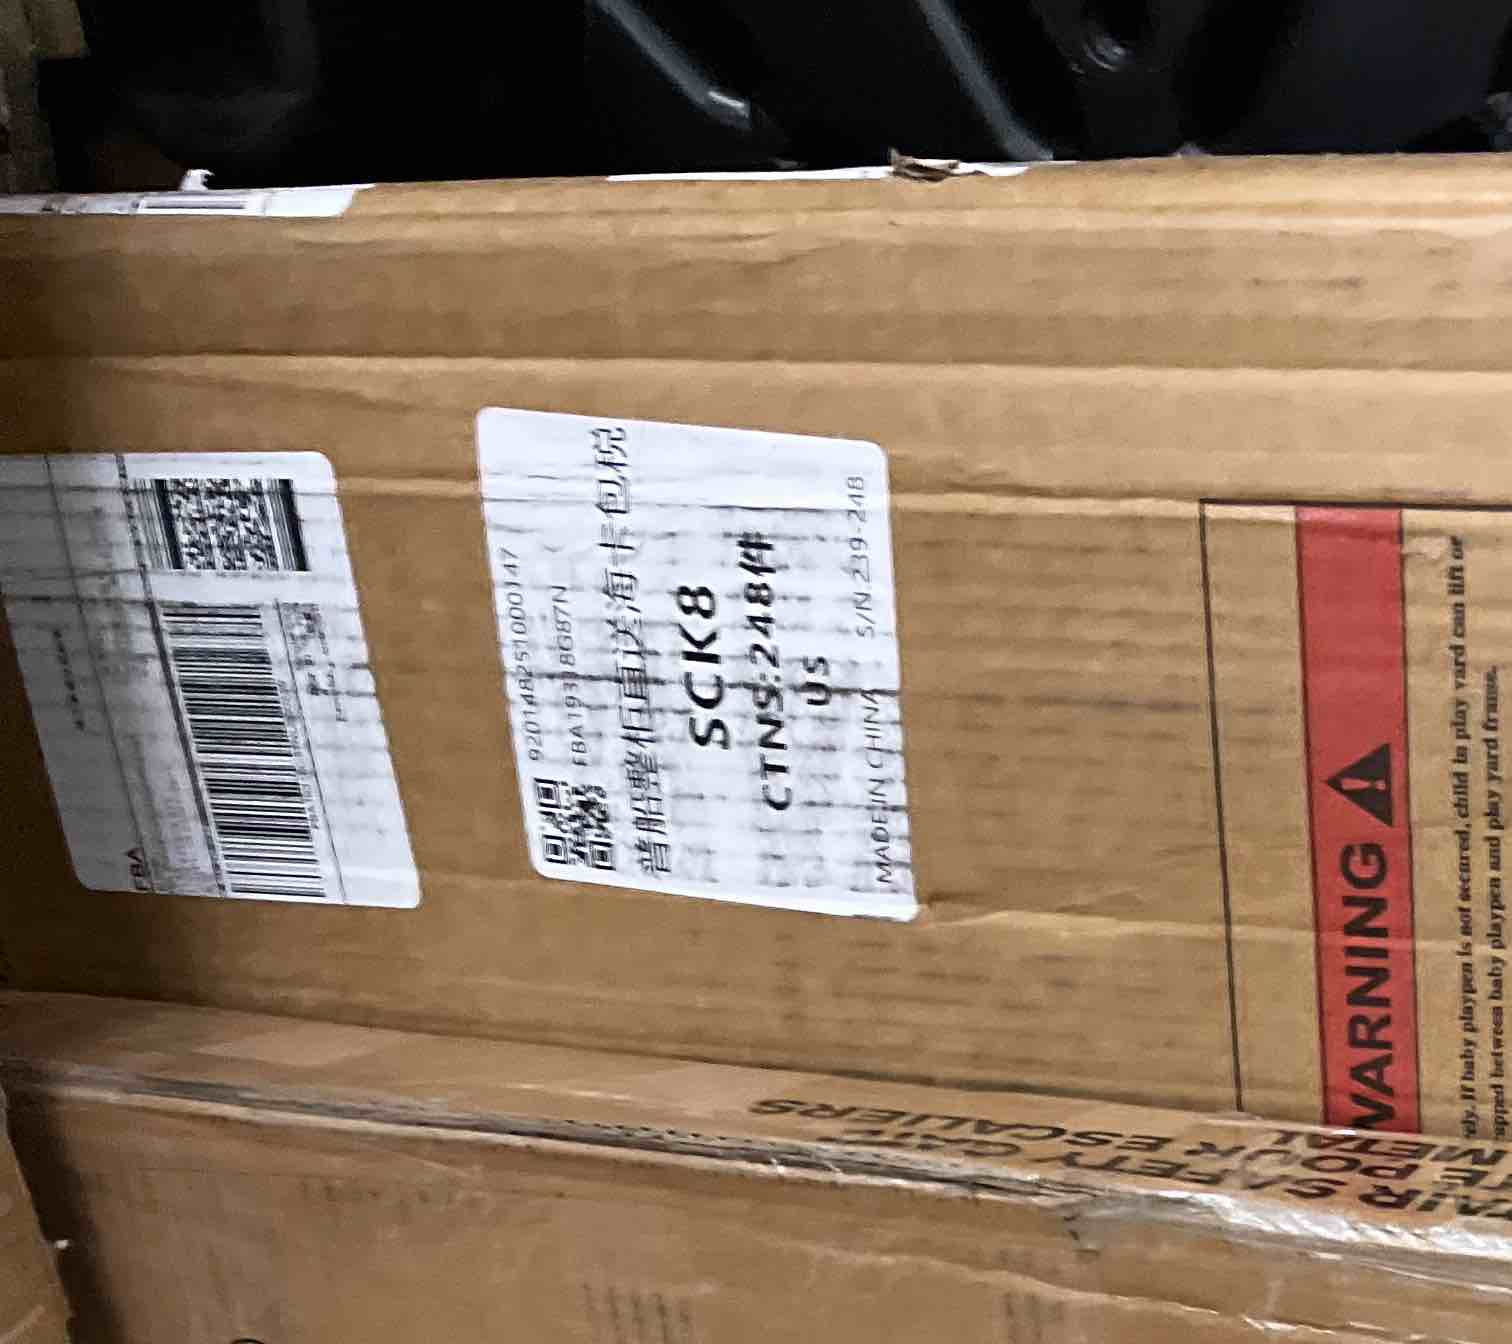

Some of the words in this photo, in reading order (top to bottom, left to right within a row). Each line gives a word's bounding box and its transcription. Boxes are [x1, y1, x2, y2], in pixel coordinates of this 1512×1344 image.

[1454, 602, 1465, 637] can
[676, 583, 730, 750] SCK8
[806, 656, 832, 706] US
[860, 687, 884, 769] CHINA
[1453, 699, 1470, 739] play
[1454, 746, 1467, 764] in
[1484, 738, 1502, 783] yard
[866, 777, 886, 803] IN
[1455, 771, 1468, 818] child
[1485, 790, 1502, 830] play
[868, 810, 892, 883] MADE
[1486, 835, 1500, 870] and
[1486, 877, 1505, 949] playpen
[1459, 961, 1476, 1032] playpen
[1488, 954, 1505, 1000] baby
[1460, 1038, 1477, 1081] baby
[742, 1097, 1176, 1154] ESCALIERS
